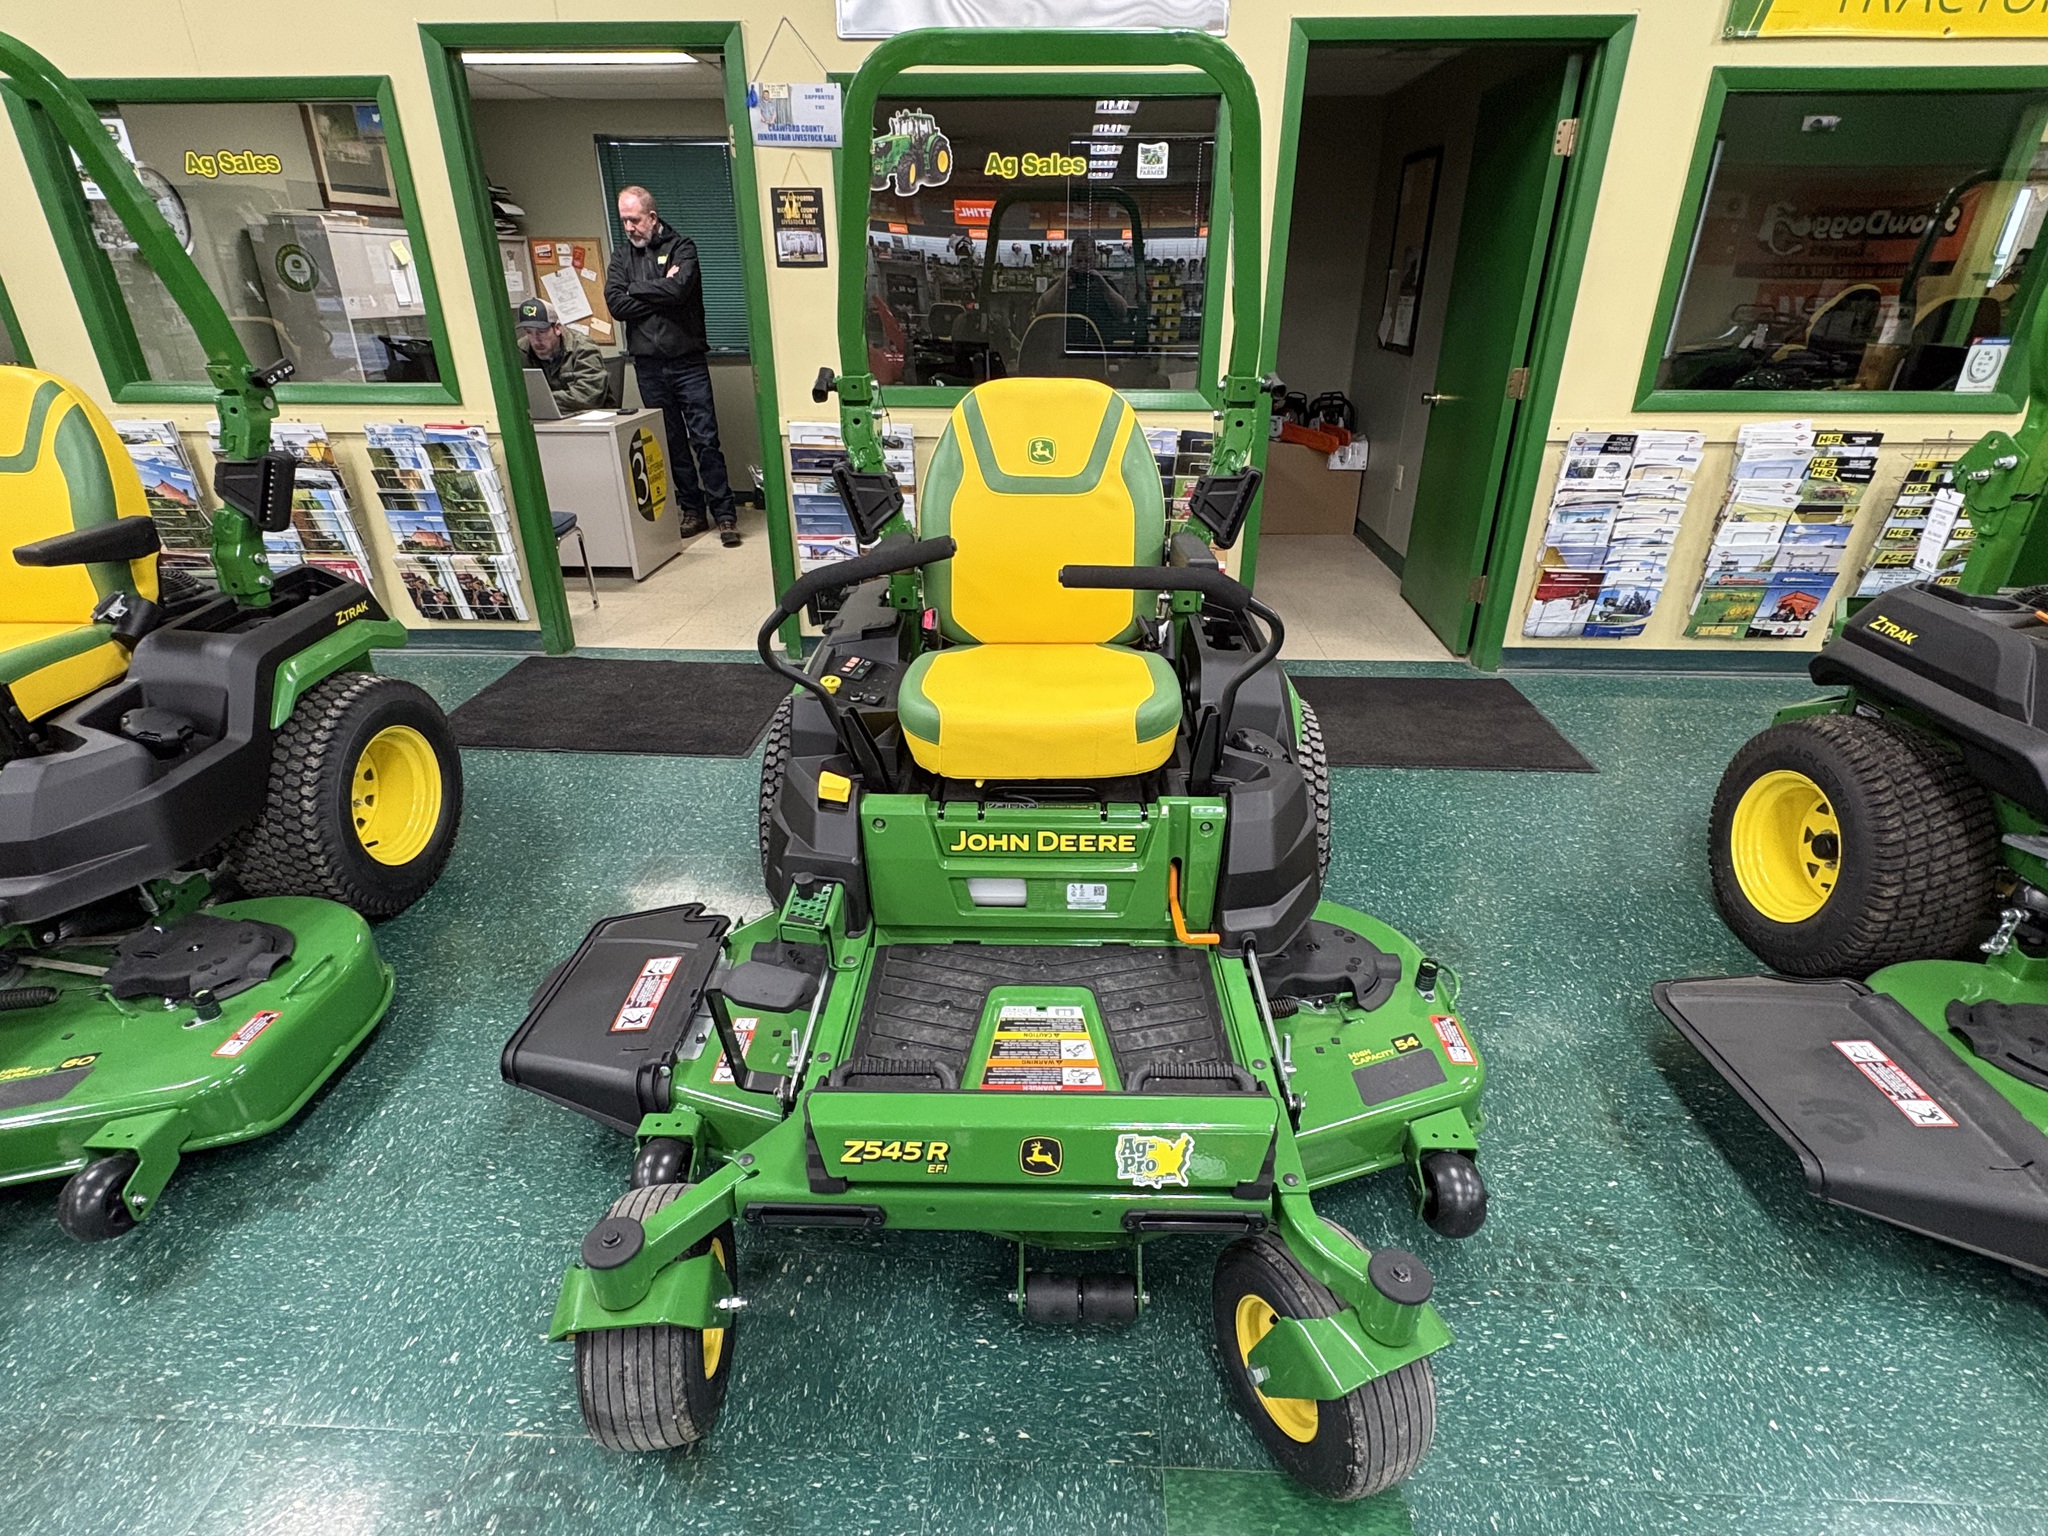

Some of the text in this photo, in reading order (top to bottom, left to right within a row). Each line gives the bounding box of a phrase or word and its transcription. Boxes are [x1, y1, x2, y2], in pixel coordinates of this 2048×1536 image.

[768, 123, 824, 133] CRAWFORD COUNTY
[757, 133, 838, 143] JUNIOR FAIR LIVESTOCK SALE
[185, 150, 282, 178] Ag Sales
[985, 152, 1087, 179] Ag Sales
[335, 600, 369, 626] ZTRAK
[1869, 615, 1919, 645] ZTRAK
[950, 830, 1136, 852] JOHN DEERE
[1394, 1036, 1420, 1051] 54
[60, 1055, 97, 1069] 60
[1348, 1048, 1372, 1060] HIGH
[1352, 1048, 1395, 1066] CAPACITY
[840, 1140, 950, 1164] Z545 R
[1120, 1137, 1156, 1159] Ag-
[927, 1164, 949, 1174] EFI
[1121, 1156, 1158, 1174] Pro
